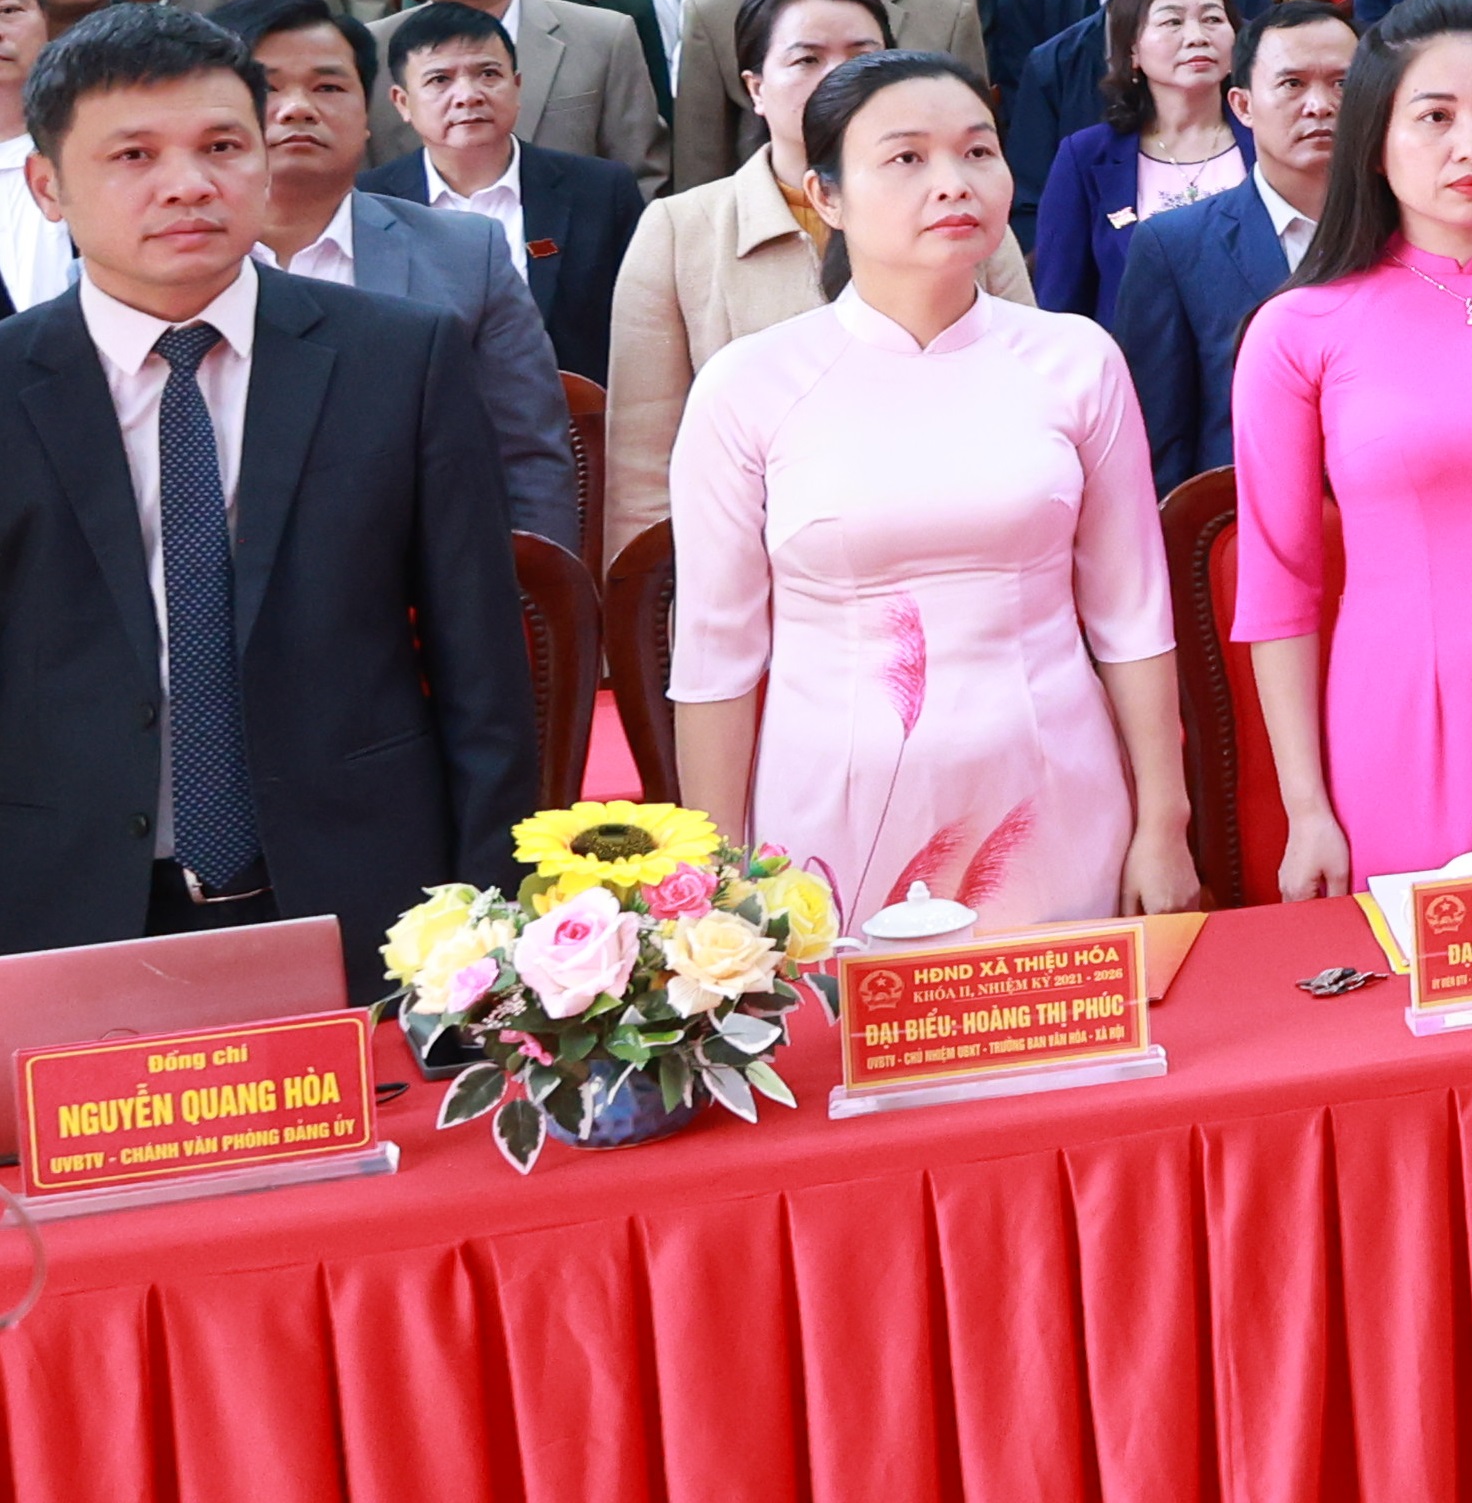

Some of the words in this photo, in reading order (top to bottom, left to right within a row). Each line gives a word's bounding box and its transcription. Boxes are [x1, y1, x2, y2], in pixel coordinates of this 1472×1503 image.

[913, 987, 956, 1004] KHÓA
[977, 976, 1028, 997] NHIỆM
[1054, 972, 1083, 987] 2021
[1094, 968, 1123, 980] 2026
[914, 964, 974, 985] HĐND
[980, 956, 1009, 977] XÃ
[1014, 950, 1068, 974] THIỆU
[1075, 944, 1119, 966] HÓA
[865, 1022, 899, 1050] ĐẠI
[905, 1008, 958, 1042] BIỂU:
[963, 1006, 1031, 1035] HOÀNG
[1035, 1003, 1068, 1028] THỊ
[1073, 991, 1124, 1021] PHÚC
[148, 1049, 206, 1074] Đồng
[213, 1044, 248, 1066] chí
[58, 1083, 173, 1138] NGUYỄN
[181, 1080, 277, 1125] QUANG
[284, 1066, 341, 1109] HÒA
[50, 1152, 105, 1174] UVBTV
[120, 1139, 179, 1165] CHÁNH
[183, 1134, 218, 1157] VĂN
[222, 1128, 280, 1152] PHÒNG
[284, 1118, 330, 1143] ĐẢNG
